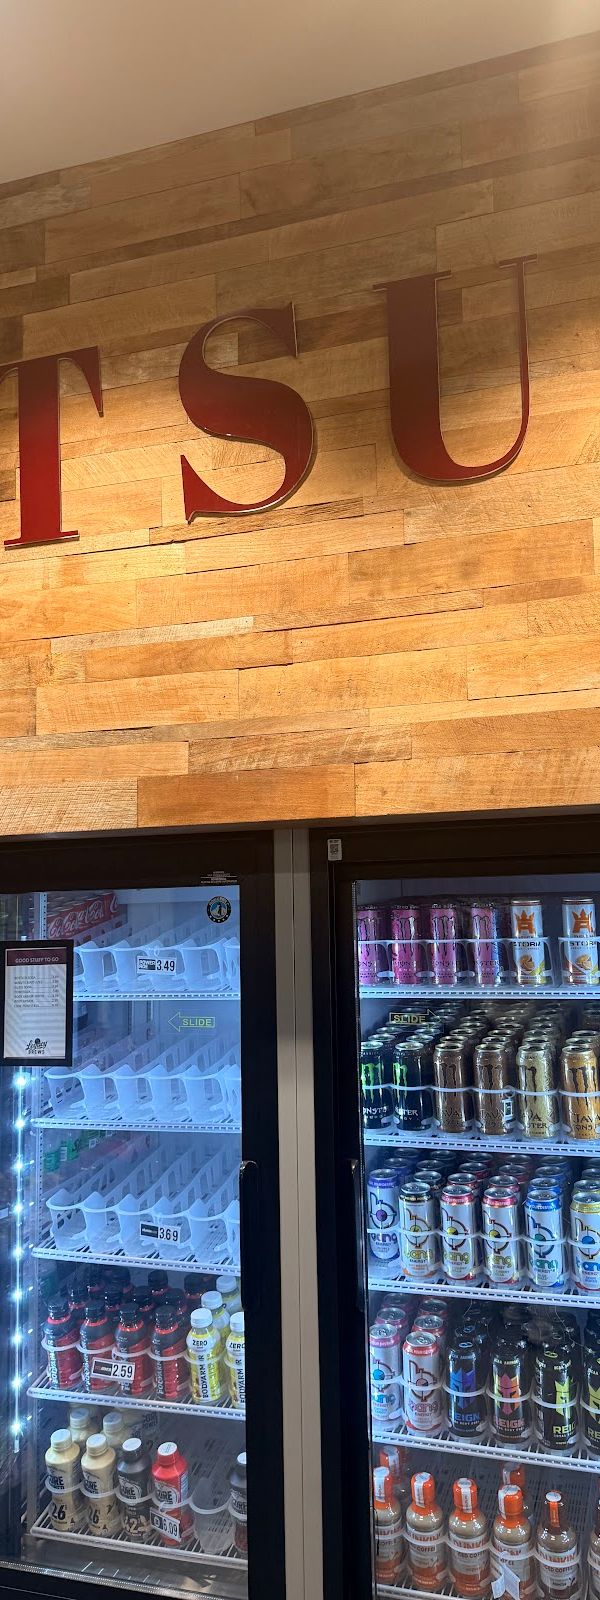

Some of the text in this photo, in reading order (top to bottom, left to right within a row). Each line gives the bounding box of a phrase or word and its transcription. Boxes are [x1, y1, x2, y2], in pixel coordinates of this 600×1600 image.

[156, 959, 175, 972] 3.49
[182, 1018, 212, 1026] SLIDE
[393, 1014, 426, 1024] SLIDE
[192, 1339, 208, 1347] ZERO
[113, 1364, 133, 1379] 2.59
[199, 1354, 209, 1399] BODYARMR
